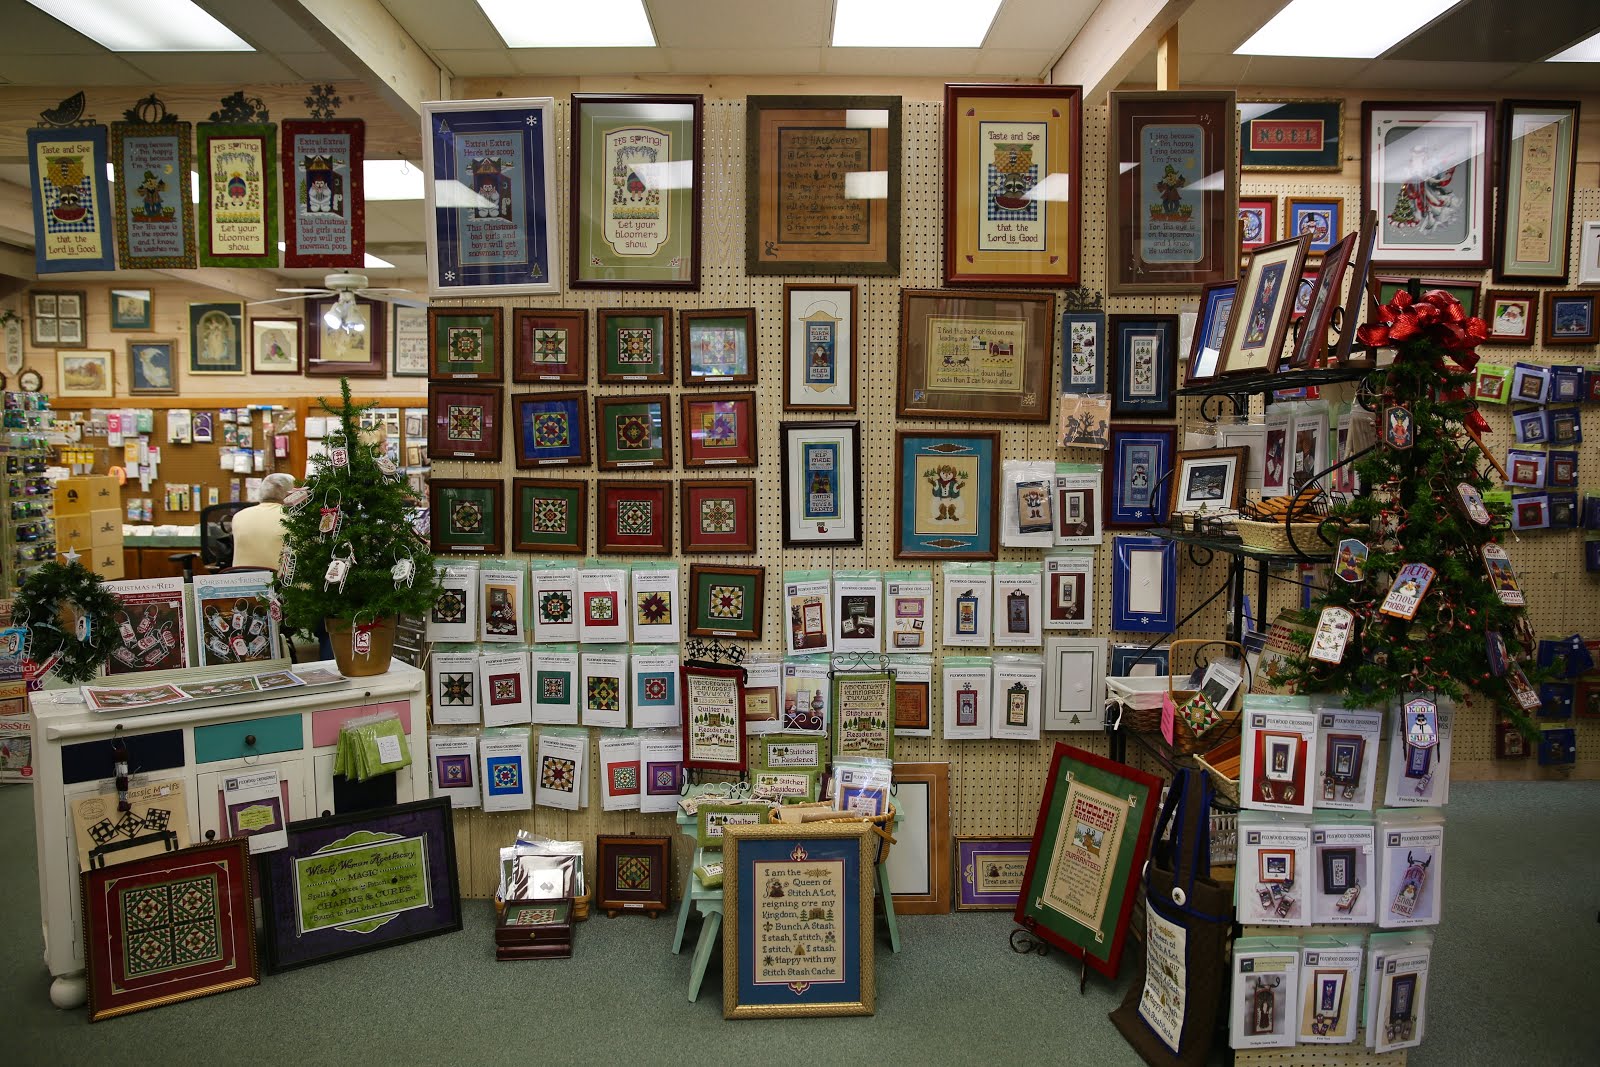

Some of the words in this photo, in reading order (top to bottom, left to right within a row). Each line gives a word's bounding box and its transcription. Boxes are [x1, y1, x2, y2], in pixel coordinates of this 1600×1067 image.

[988, 131, 1007, 140] Taste
[1010, 132, 1023, 140] and
[1027, 132, 1040, 140] See
[1260, 129, 1314, 142] NOEL
[41, 145, 60, 154] Taste
[62, 146, 75, 154] and
[77, 144, 91, 153] See
[239, 225, 257, 235] your
[618, 222, 632, 231] Let
[635, 222, 655, 233] your
[74, 235, 87, 243] the
[219, 233, 260, 242] bloomers
[615, 231, 658, 240] bloomers
[988, 234, 1006, 242] Lord
[1009, 234, 1015, 242] is
[1018, 234, 1038, 242] Good
[48, 246, 66, 254] Lord
[68, 246, 74, 254] is
[77, 245, 96, 254] Good
[1401, 565, 1433, 581] ACME
[1389, 592, 1418, 605] SNOW
[1383, 600, 1415, 614] MOBILE
[781, 755, 814, 763] Residence
[1076, 799, 1115, 824] RUDOLPH
[1073, 810, 1095, 825] BRAND
[1095, 819, 1113, 831] CHOW
[306, 864, 338, 877] Witchy
[338, 858, 369, 870] Woman
[370, 852, 415, 867] Apothecary
[1065, 850, 1102, 872] GUARANTEED
[348, 869, 378, 880] MAGIC
[793, 878, 819, 886] Queen
[307, 888, 330, 901] Spells
[367, 879, 392, 889] Potions
[787, 889, 811, 897] Stitch
[820, 889, 836, 898] Lot,
[317, 896, 363, 910] CHARMS
[376, 885, 411, 898] CURES
[346, 907, 359, 916] heal
[361, 903, 378, 913] what
[380, 898, 403, 908] haunts
[763, 901, 799, 910] reigning
[822, 900, 835, 908] my
[763, 911, 799, 920] Kingdom,
[775, 923, 802, 931] Bunch
[768, 934, 792, 943] stash,
[769, 945, 793, 954] stitch,
[775, 956, 801, 965] Happy
[803, 956, 822, 964] with
[824, 956, 836, 965] my
[763, 968, 787, 977] Stitch
[788, 968, 811, 976] Stash
